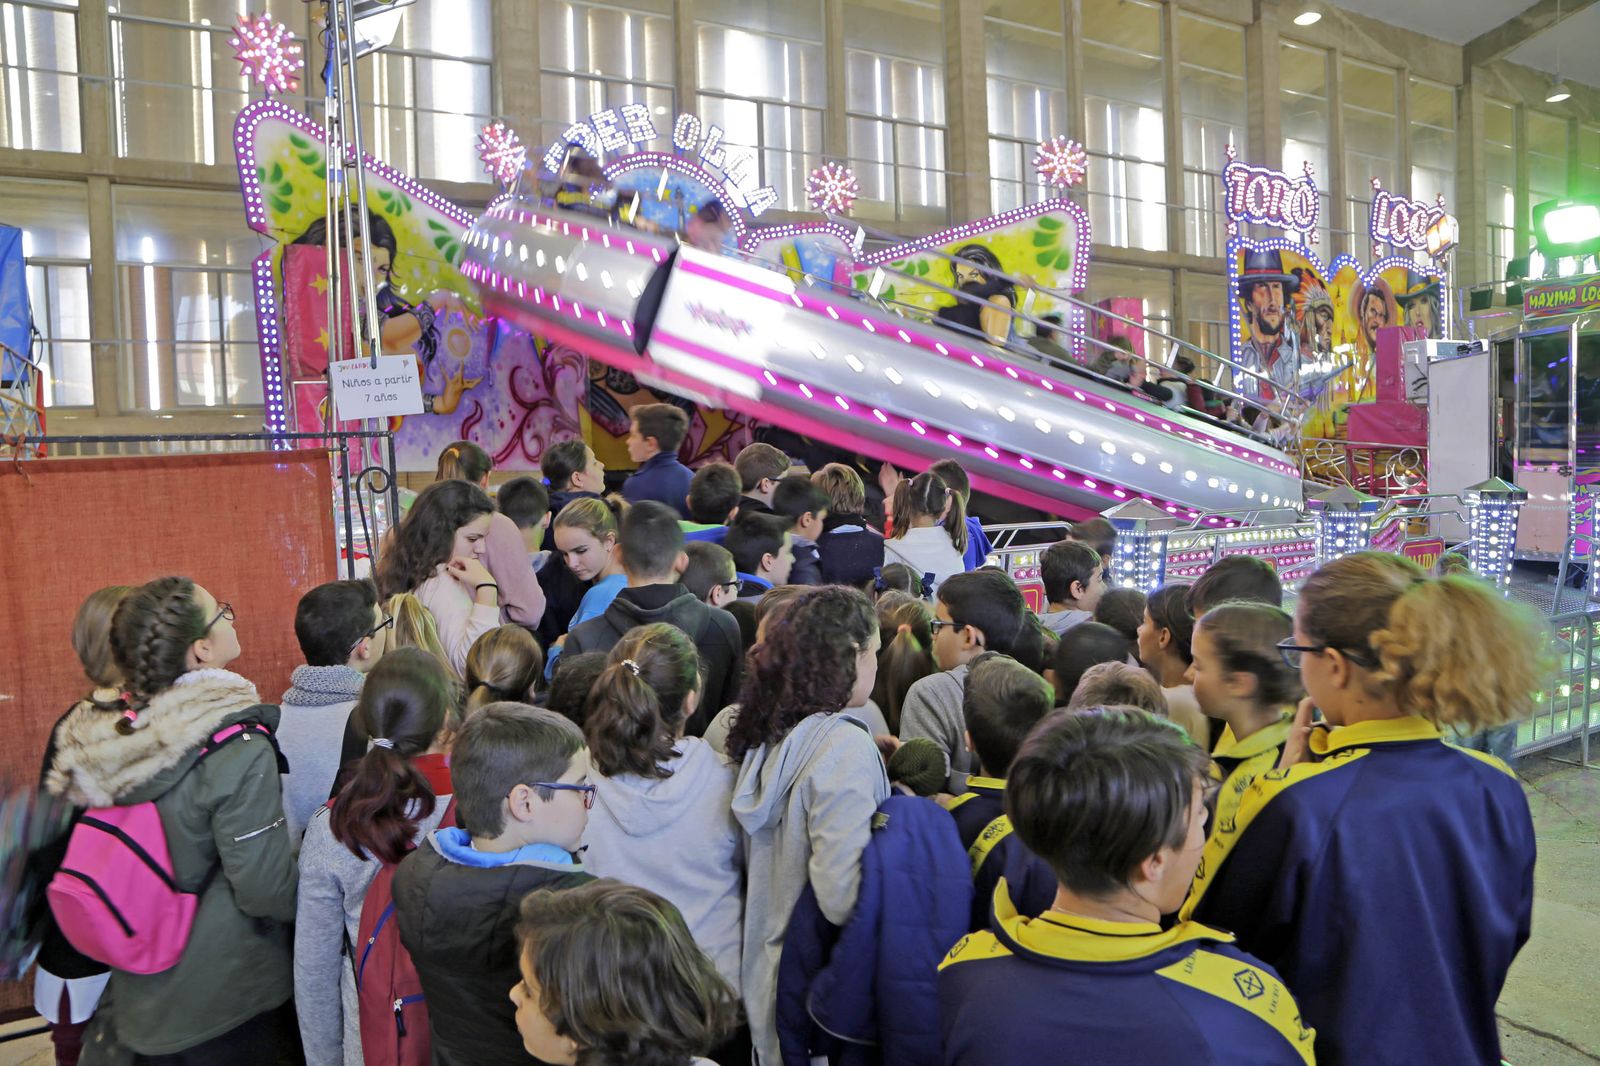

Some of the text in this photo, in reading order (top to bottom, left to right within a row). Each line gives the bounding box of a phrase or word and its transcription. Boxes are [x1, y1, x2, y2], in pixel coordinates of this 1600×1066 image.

[1231, 169, 1315, 226] TORO
[1376, 197, 1441, 244] LOC
[1529, 285, 1600, 310] MAXIMA LO
[342, 378, 372, 388] Niños
[385, 374, 413, 387] partir
[365, 392, 398, 403] 7 años
